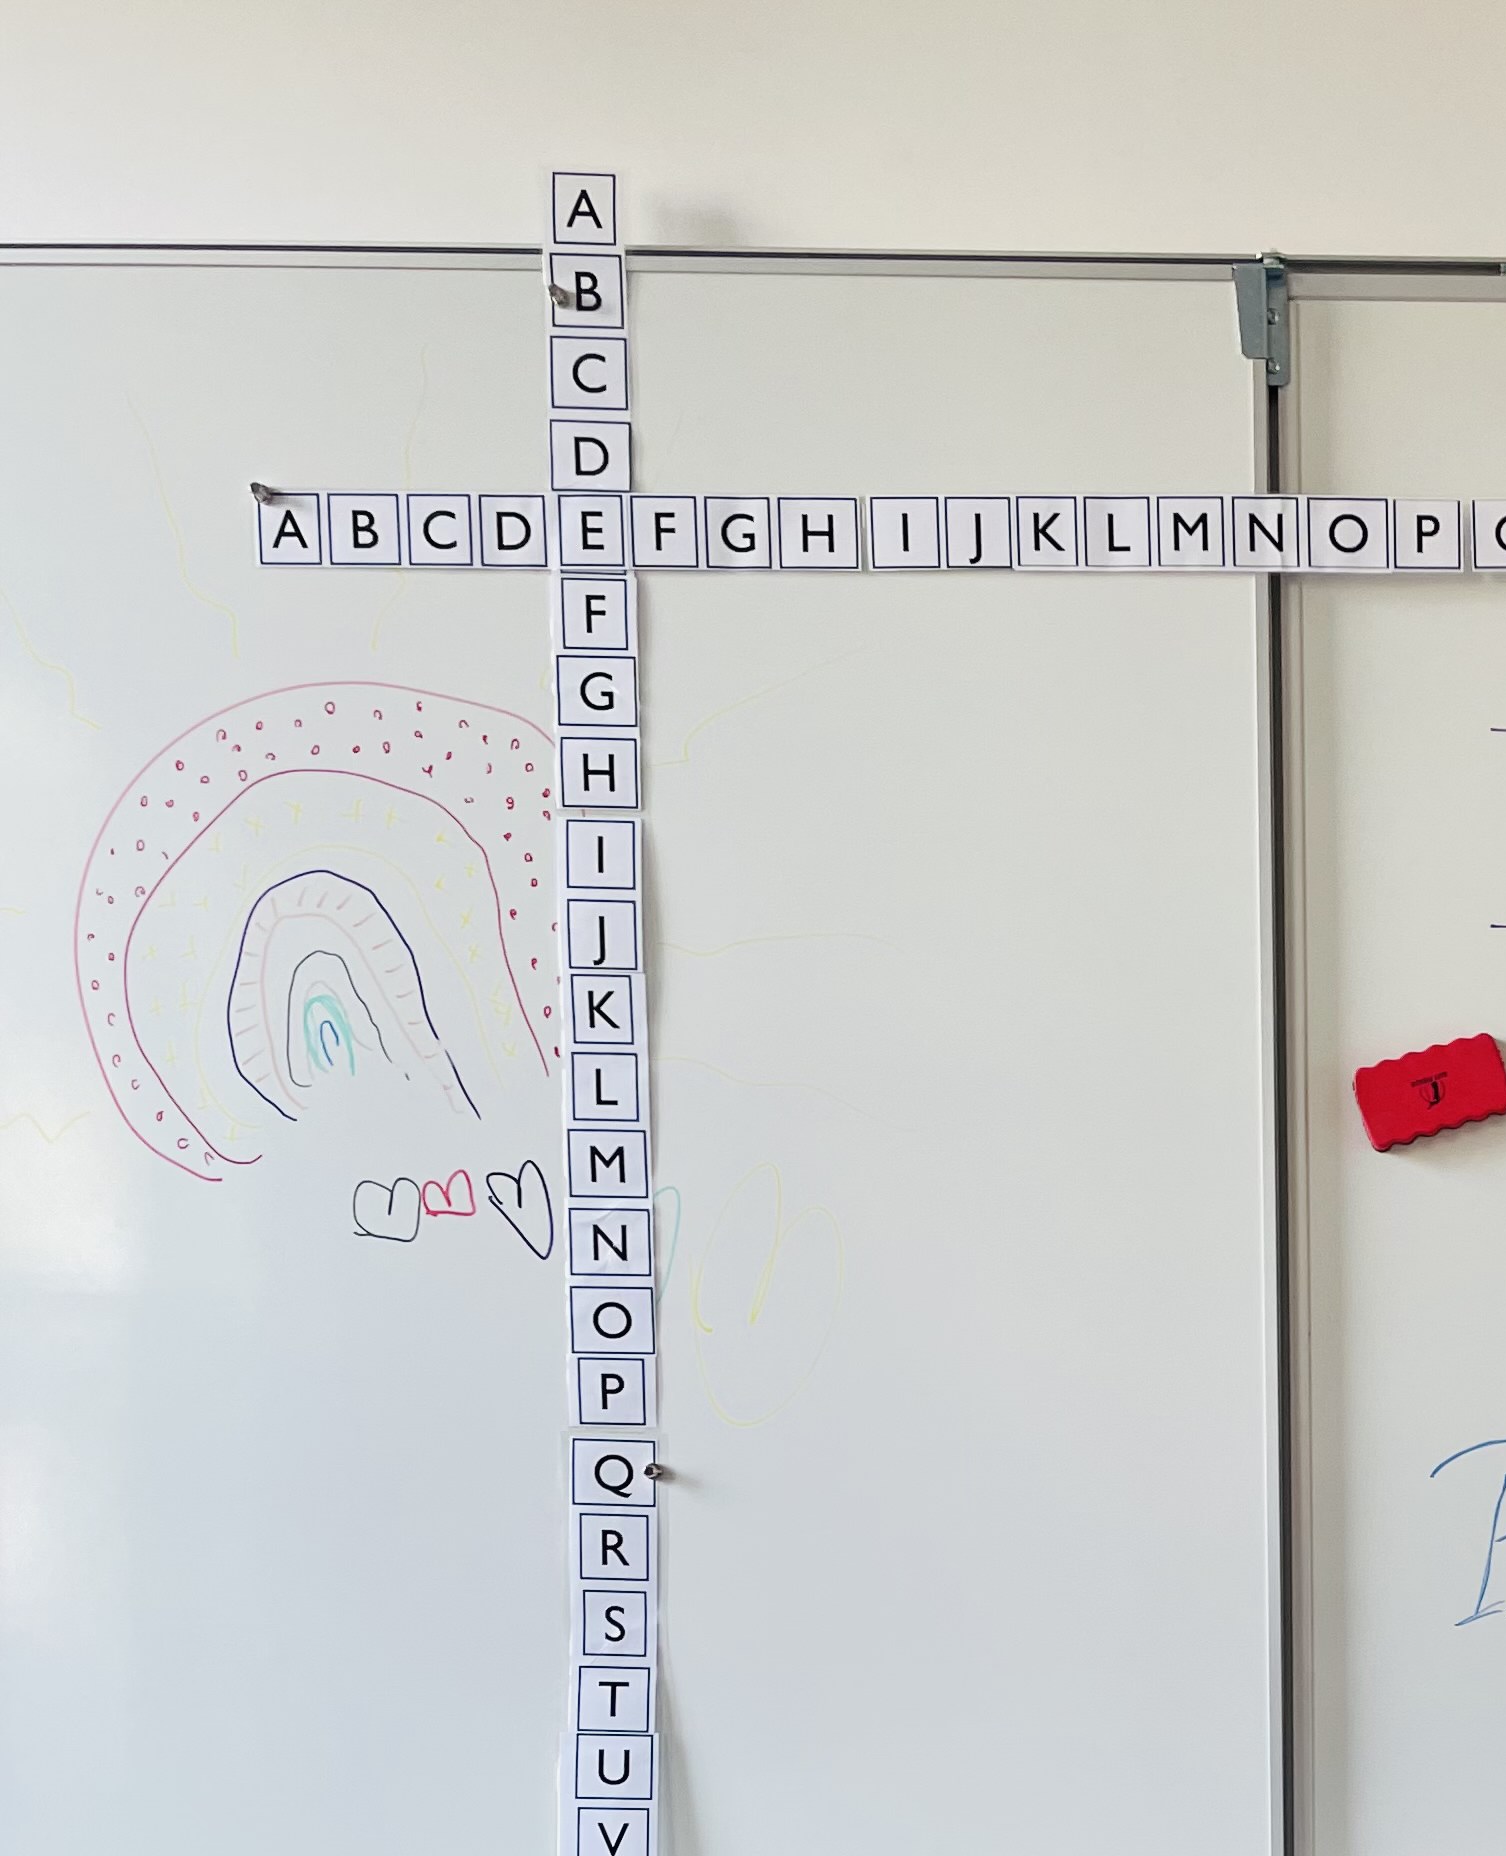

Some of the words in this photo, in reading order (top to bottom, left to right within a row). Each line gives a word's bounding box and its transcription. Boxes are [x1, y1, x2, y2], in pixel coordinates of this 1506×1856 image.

[566, 189, 603, 229] A
[574, 271, 602, 312] B
[572, 353, 607, 394] C
[574, 436, 609, 476] D
[272, 509, 309, 549] A
[351, 509, 379, 549] B
[423, 510, 457, 550] C
[495, 511, 532, 551] D
[580, 511, 605, 551] E
[654, 512, 676, 551] F
[720, 513, 756, 553] G
[801, 513, 835, 553] H
[969, 513, 982, 565] J
[1032, 512, 1065, 552] K
[1107, 513, 1131, 552] L
[1173, 512, 1209, 552] M
[1248, 512, 1284, 553] N
[1328, 513, 1369, 553] O
[1416, 514, 1440, 554] P
[585, 594, 606, 634] F
[580, 671, 614, 711] G
[582, 753, 616, 793] H
[593, 915, 606, 966] J
[587, 990, 620, 1029] K
[595, 1068, 619, 1106] L
[589, 1145, 626, 1184] M
[592, 1224, 628, 1262] N
[592, 1301, 633, 1339] O
[600, 1373, 625, 1410] P
[594, 1454, 634, 1499] Q
[601, 1529, 630, 1566] R
[604, 1605, 626, 1642] S
[598, 1681, 630, 1717] T
[598, 1749, 630, 1786] U
